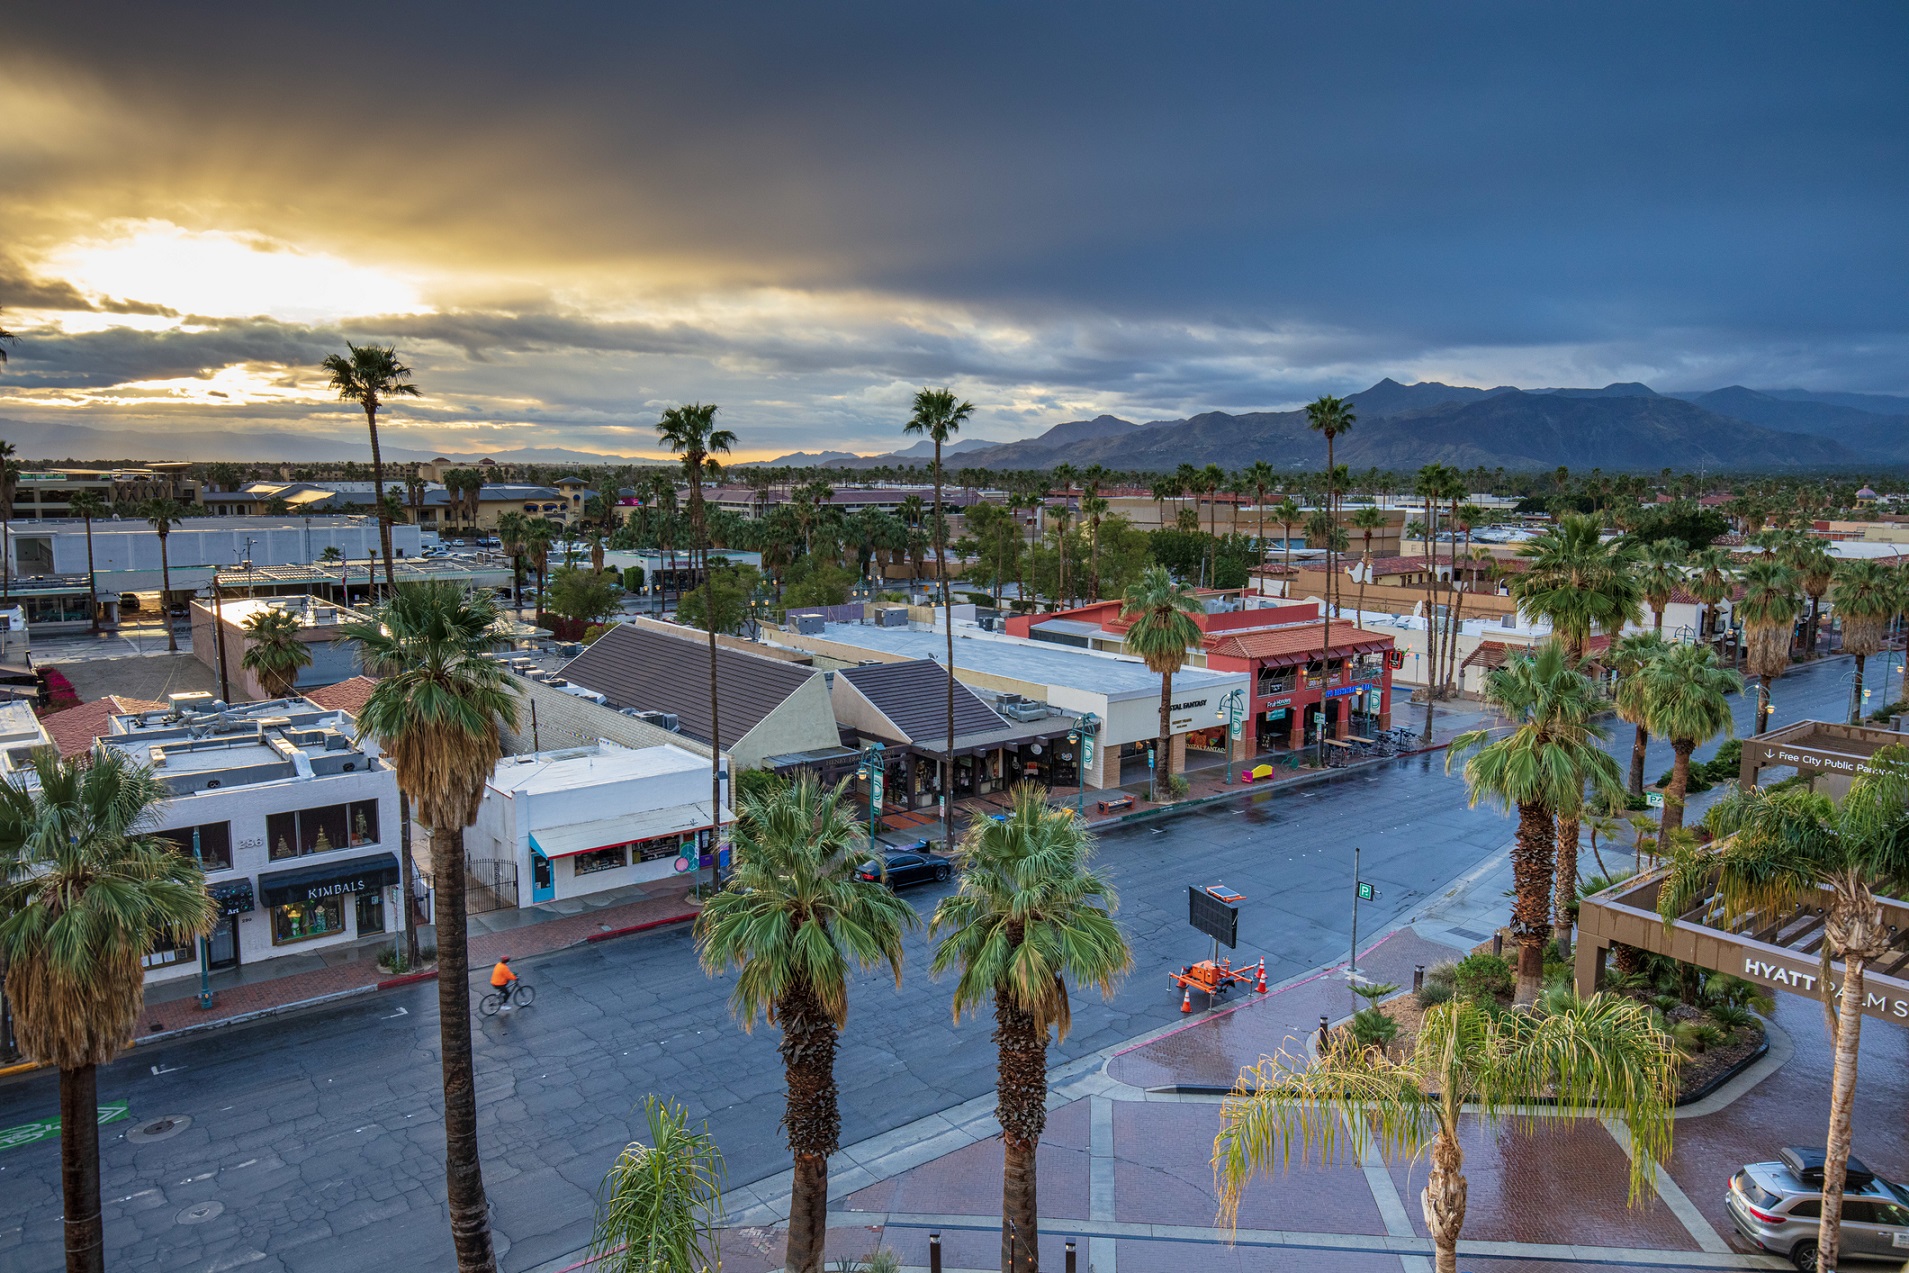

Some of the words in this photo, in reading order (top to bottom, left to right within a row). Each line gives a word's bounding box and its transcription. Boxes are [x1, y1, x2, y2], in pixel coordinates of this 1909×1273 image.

[1182, 699, 1208, 710] FANTASY
[1778, 751, 1799, 762] Free
[1802, 755, 1821, 767] City
[1824, 758, 1854, 771] Public
[236, 837, 264, 850] 286
[308, 880, 366, 899] KIMBALS
[227, 907, 240, 916] Art
[1744, 958, 1817, 991] HYATT
